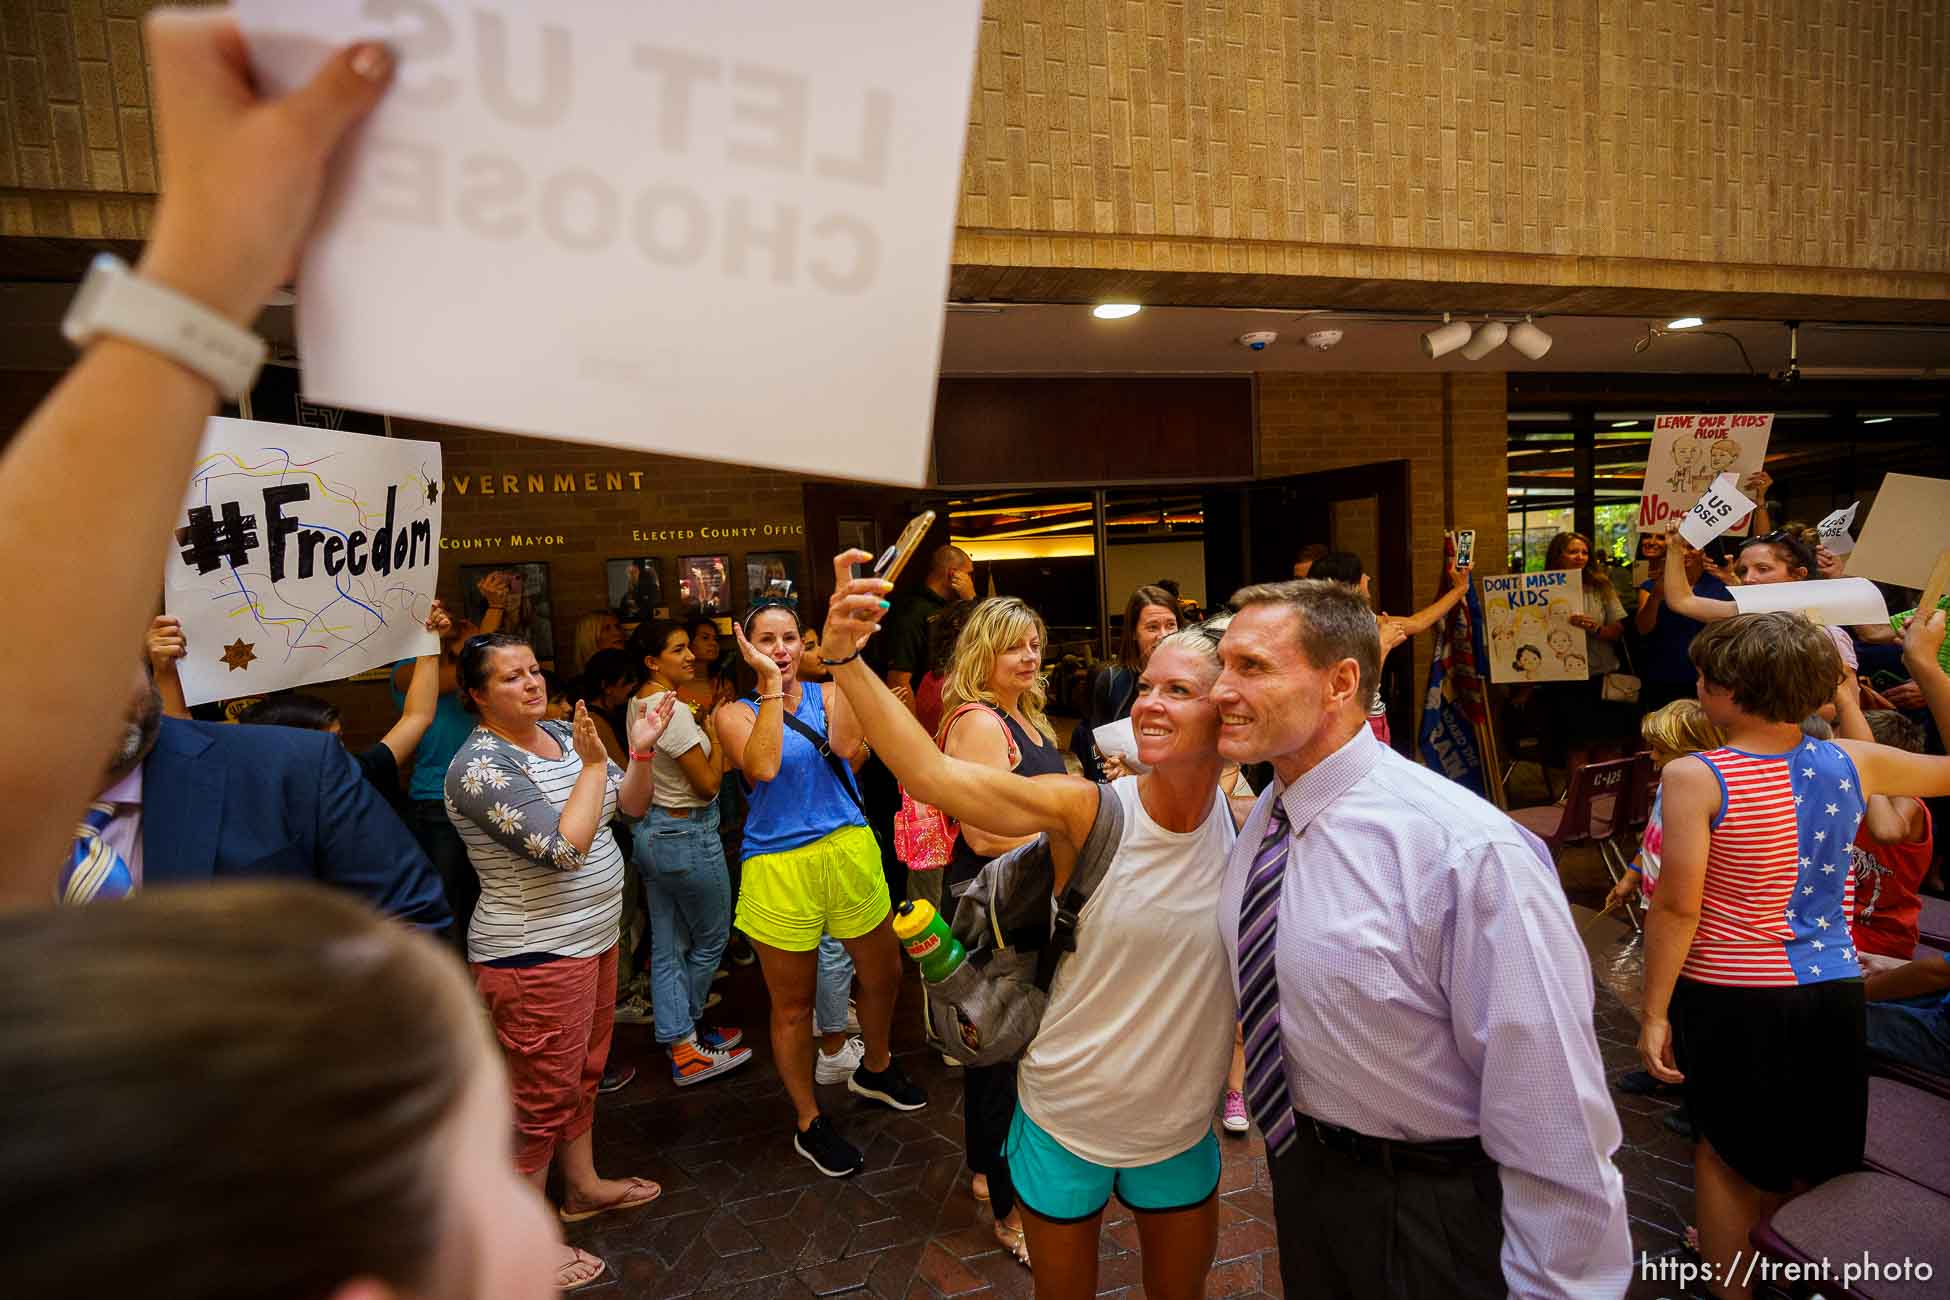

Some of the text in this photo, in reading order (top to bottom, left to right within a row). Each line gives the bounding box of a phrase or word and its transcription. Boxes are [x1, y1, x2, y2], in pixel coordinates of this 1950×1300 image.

[1656, 415, 1768, 429] LEAVE OUR KIDS
[441, 471, 648, 496] VERNMENT
[1708, 495, 1732, 517] US
[1694, 504, 1719, 527] OSE
[440, 535, 566, 550] COUNTY MAYOR
[633, 529, 694, 542] ELECTED
[701, 527, 757, 539] COUNTY
[1526, 573, 1567, 588] MASK
[1507, 589, 1549, 610] KIDS
